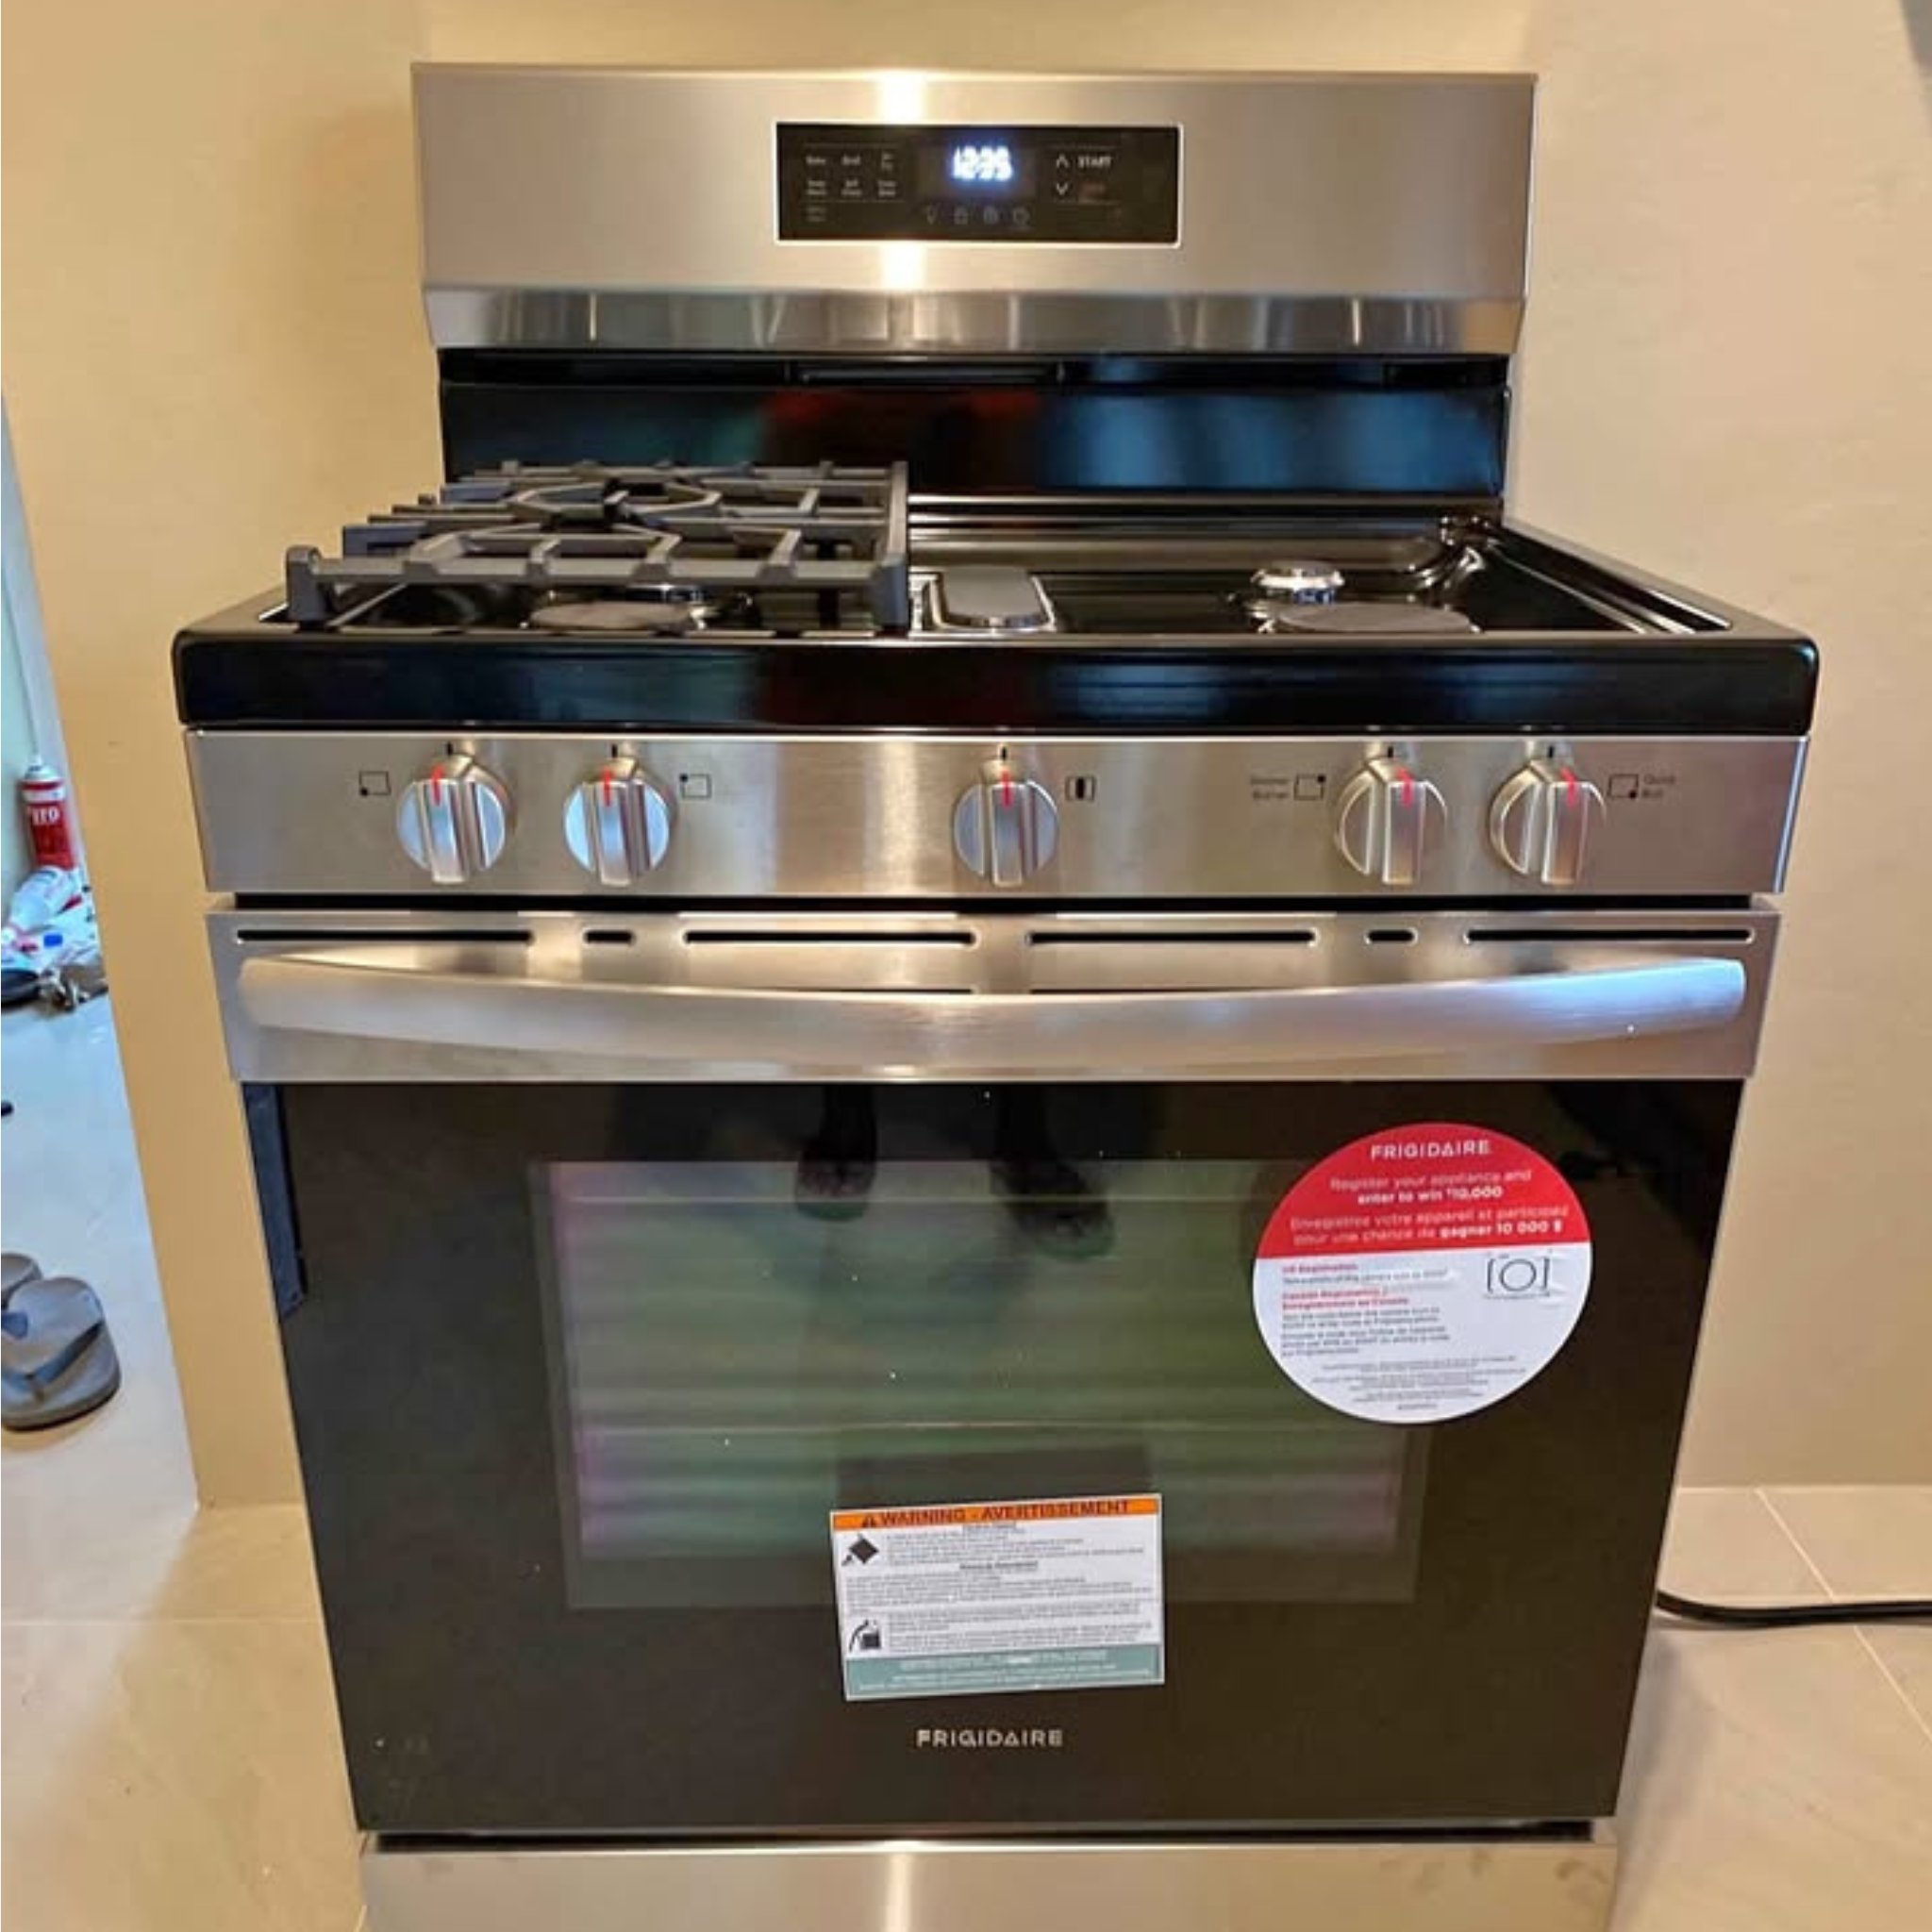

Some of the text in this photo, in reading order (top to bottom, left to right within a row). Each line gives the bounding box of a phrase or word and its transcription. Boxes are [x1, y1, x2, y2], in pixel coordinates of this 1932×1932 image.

[1371, 1140, 1491, 1161] FRIGIDAIRE
[1504, 1170, 1532, 1182] and
[1357, 1192, 1395, 1206] enter
[1417, 1190, 1443, 1202] win
[880, 1509, 965, 1527] WARNING
[981, 1500, 1130, 1522] AVERTISSEMENT
[916, 1729, 1063, 1747] FRIGIDAIRE
